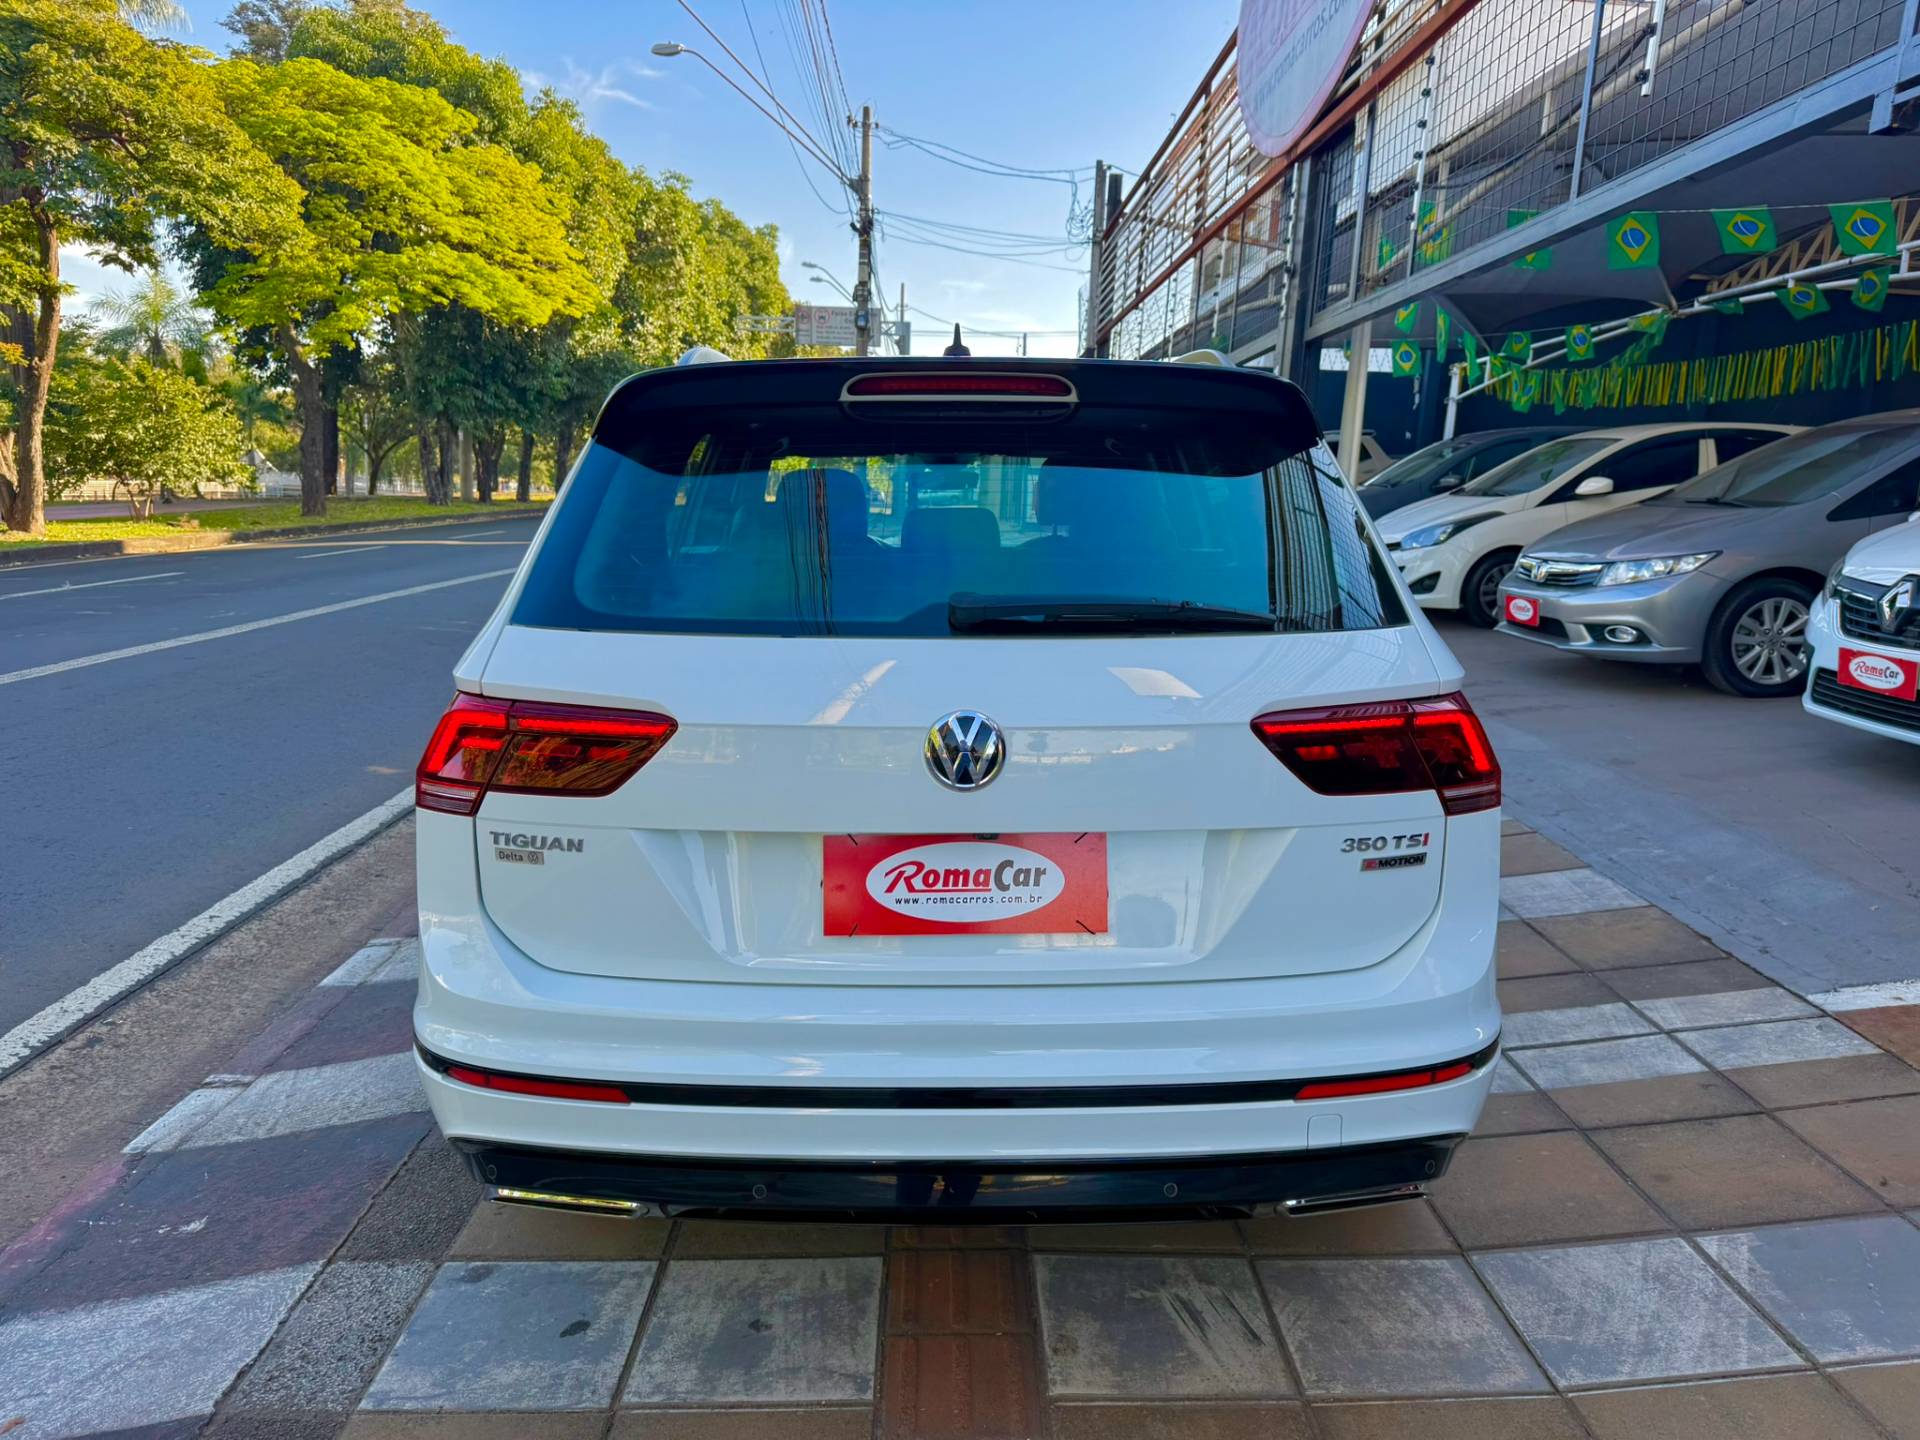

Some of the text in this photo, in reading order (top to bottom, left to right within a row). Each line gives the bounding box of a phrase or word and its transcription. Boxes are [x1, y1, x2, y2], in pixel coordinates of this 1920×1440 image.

[489, 831, 584, 852] TIGUAN
[1392, 832, 1430, 849] TSI
[498, 850, 523, 861] Delta
[884, 860, 1047, 893] RomaCar
[895, 894, 1043, 905] www.romacarros.com.br
